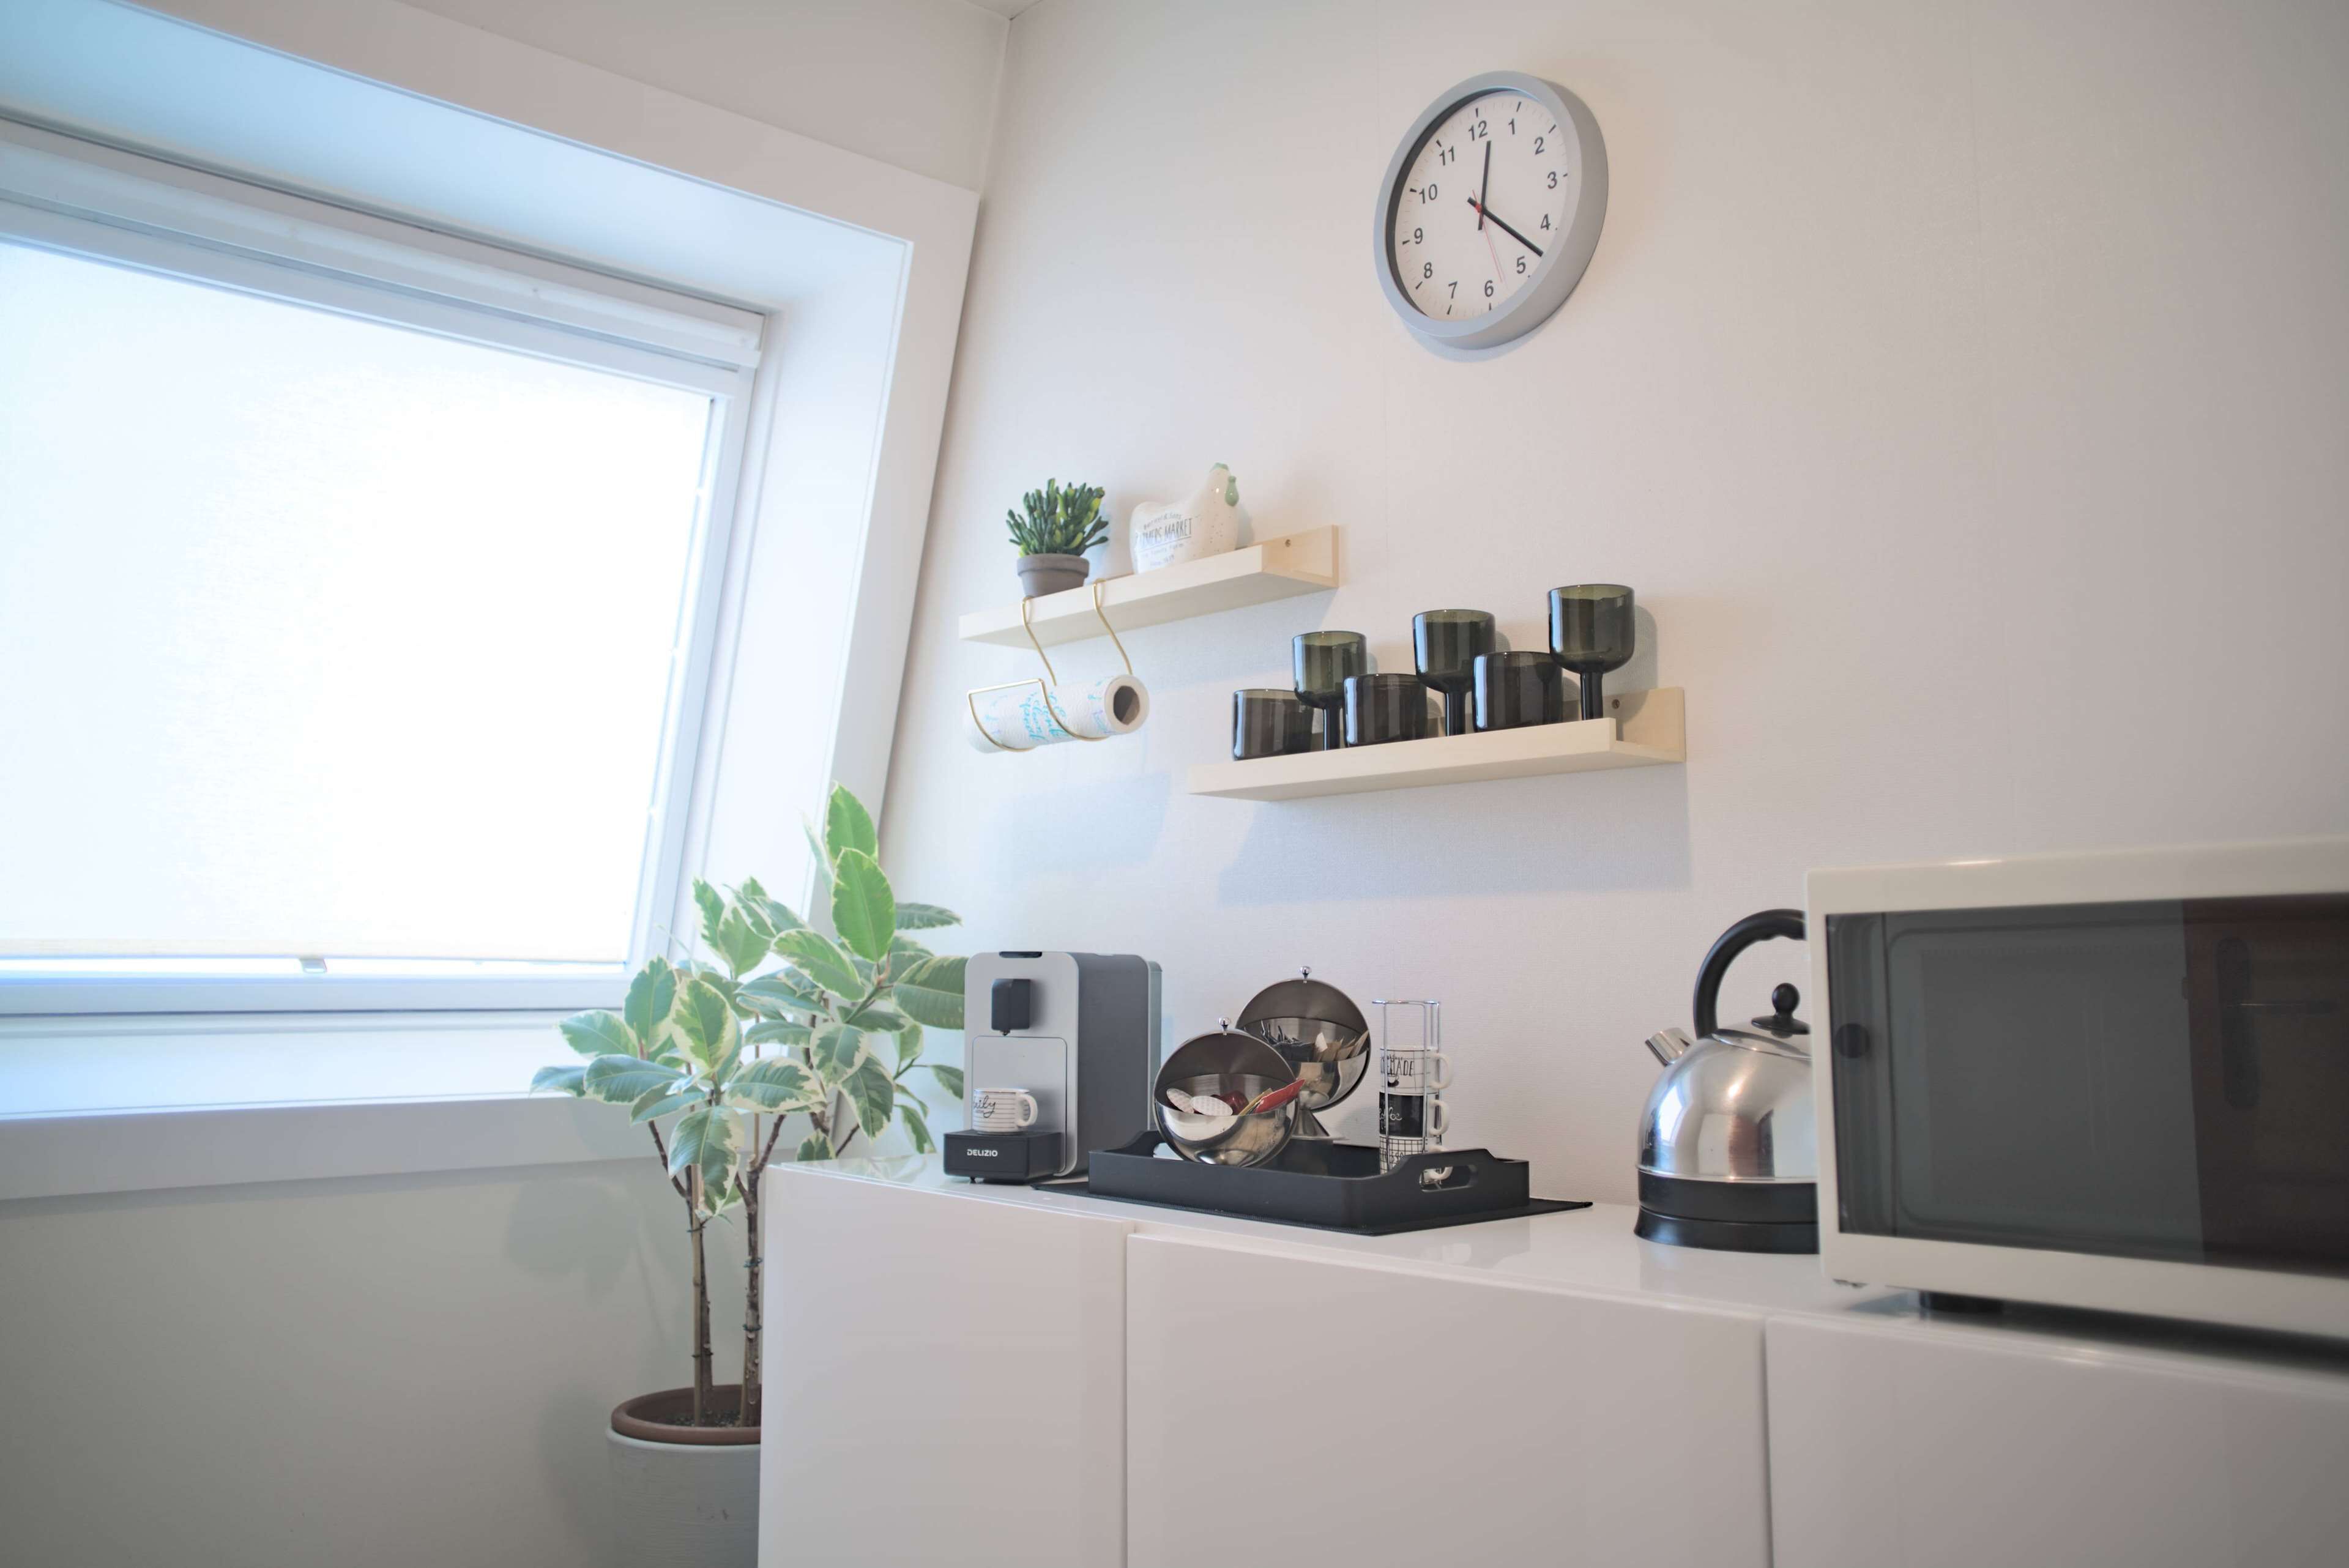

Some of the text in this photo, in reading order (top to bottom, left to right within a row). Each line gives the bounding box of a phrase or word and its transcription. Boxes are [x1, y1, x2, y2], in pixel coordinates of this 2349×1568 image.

[1469, 120, 1489, 141] 12
[1508, 119, 1516, 136] 1
[1534, 136, 1545, 155] 2
[1440, 146, 1455, 166] 11
[1547, 171, 1558, 189] 3
[1419, 184, 1438, 204] 10
[1540, 214, 1551, 231] 4
[1413, 228, 1423, 244] 9
[1423, 262, 1433, 279] 8
[1516, 256, 1526, 274] 5
[1448, 281, 1457, 299] 7
[1484, 280, 1494, 297] 6
[1164, 518, 1192, 540] MARKET
